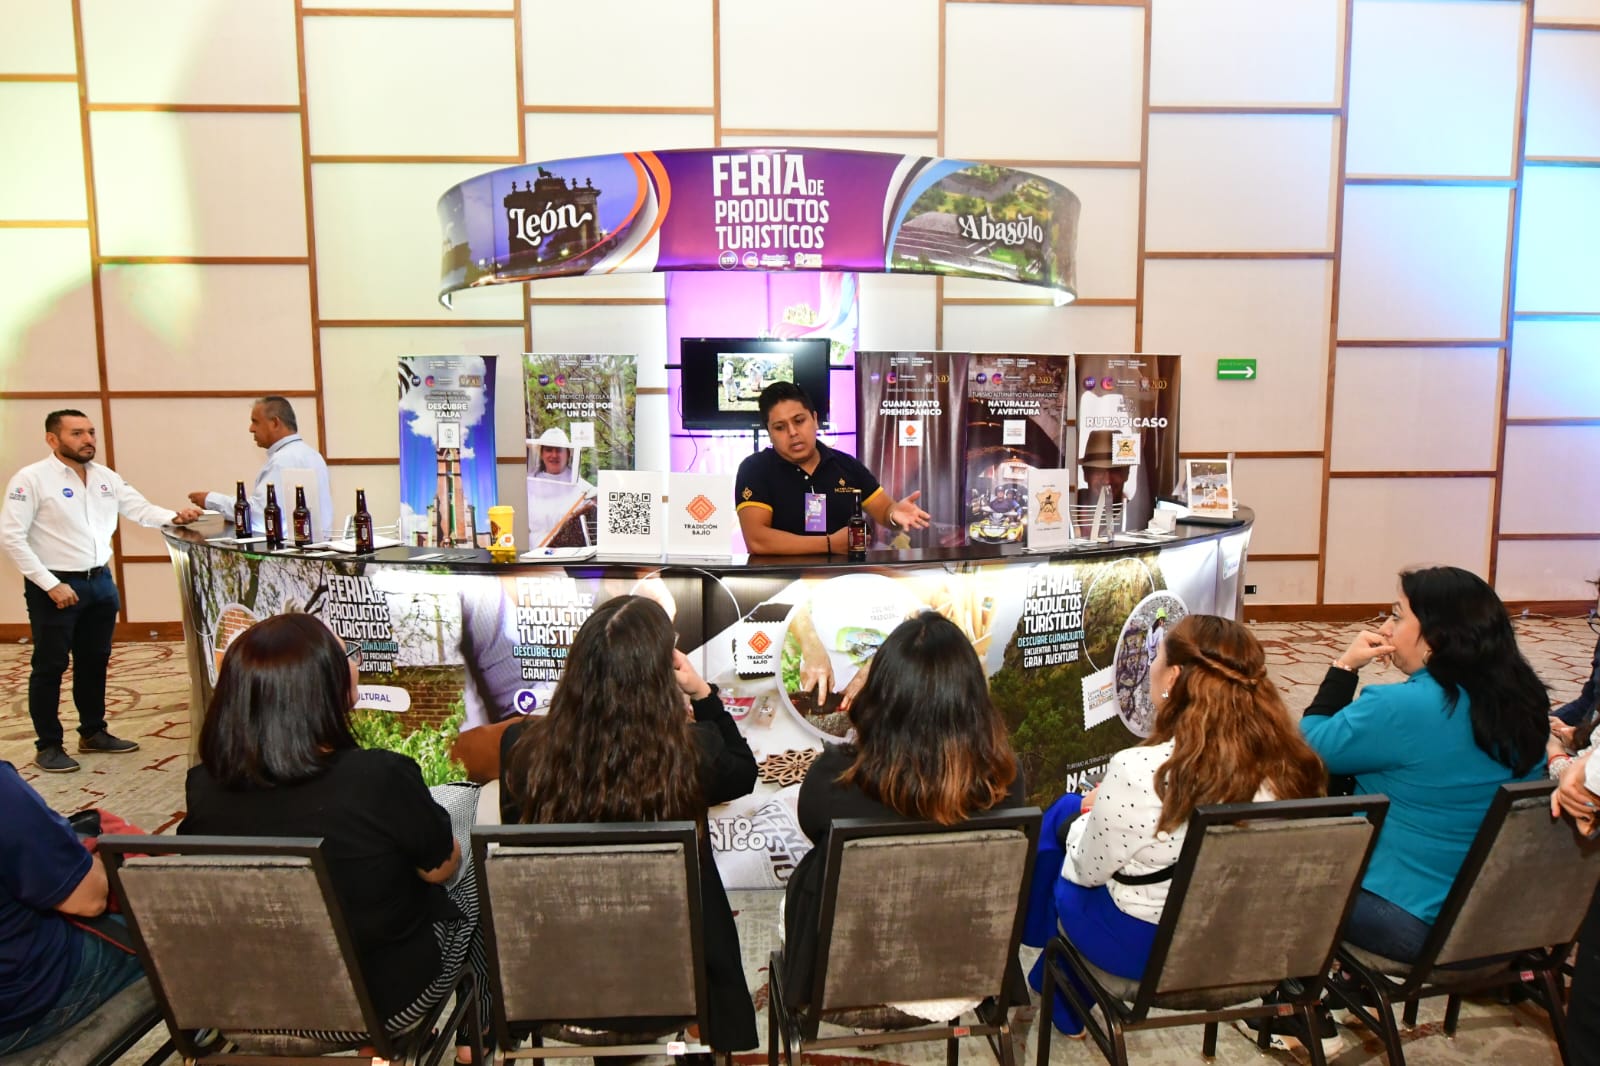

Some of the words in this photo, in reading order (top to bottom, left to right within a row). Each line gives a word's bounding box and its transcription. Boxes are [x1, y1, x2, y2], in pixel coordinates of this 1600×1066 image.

[712, 154, 808, 197] FERIA
[807, 179, 825, 196] DE
[715, 198, 830, 224] PRODUCTOS
[509, 201, 593, 246] León
[958, 213, 1044, 246] Abasolo
[715, 224, 825, 249] TURISTICOS
[547, 402, 594, 410] APICULTOR
[596, 402, 614, 410] POR
[581, 408, 596, 417] DÍA
[882, 400, 940, 408] GUANAJUATO
[987, 400, 1040, 408] NATURALEZA
[990, 408, 996, 416] Y
[997, 408, 1040, 416] AVENTURA
[327, 574, 374, 604] FERIA
[374, 591, 386, 604] DE
[516, 577, 578, 607] FERIA
[578, 592, 593, 606] DE
[1026, 569, 1075, 599] FERIA
[1073, 580, 1082, 593] DE
[329, 602, 390, 621] PRODUCTOS
[1024, 594, 1082, 617] PRODUCTOS
[331, 619, 392, 640] TURÍSTICOS
[1023, 611, 1082, 635] TURÍSTICOS
[1018, 634, 1049, 647] DESCUBRE
[1049, 630, 1085, 643] GUANAJUATO
[513, 646, 550, 657] DESCUBRE
[1024, 645, 1052, 656] ENCUENTRA
[1052, 644, 1059, 652] TU
[1024, 655, 1043, 668] GRAN
[1045, 650, 1079, 665] AVENTURA
[522, 668, 546, 680] GRAN
